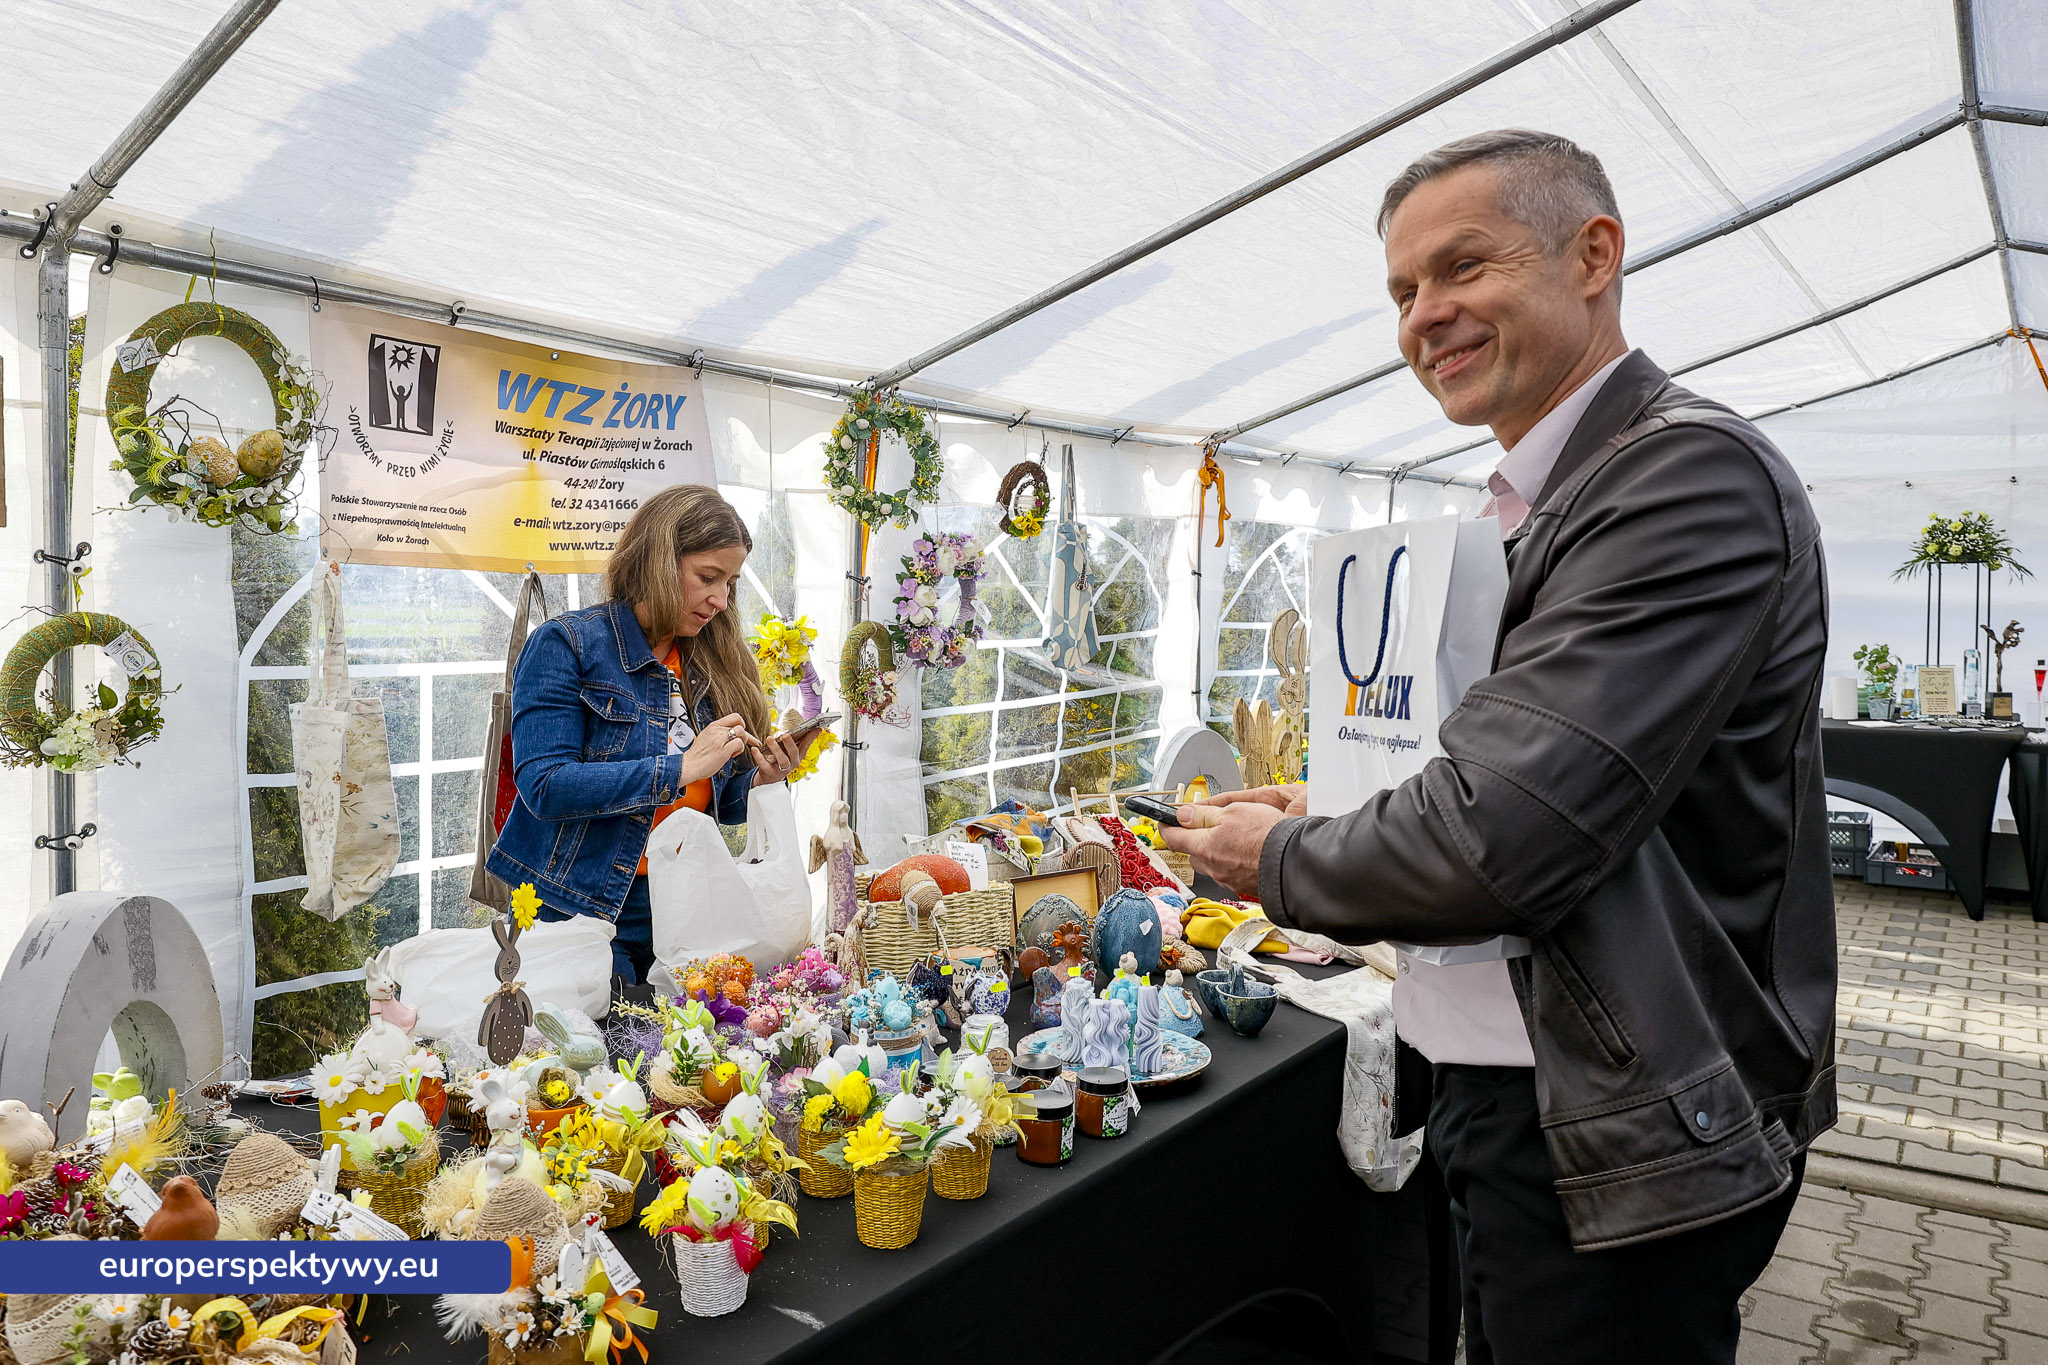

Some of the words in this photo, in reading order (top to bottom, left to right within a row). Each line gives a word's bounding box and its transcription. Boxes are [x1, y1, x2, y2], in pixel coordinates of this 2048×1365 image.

[497, 368, 606, 426] WTZ
[602, 382, 687, 430] ŻORY
[495, 420, 554, 443] Warsztaty
[557, 430, 600, 450] Terapii
[599, 437, 640, 451] Zajęciowej
[642, 440, 651, 450] w
[653, 437, 693, 451] Żorach
[386, 462, 416, 478] PRZED
[419, 453, 441, 475] NIMI
[522, 448, 537, 462] ul.
[539, 450, 590, 469] Piastów
[590, 457, 655, 472] Górnośląskich
[657, 459, 666, 470] 6
[564, 477, 598, 490] 44-240
[598, 475, 625, 492] Żory
[331, 494, 360, 505] Polskie
[361, 497, 418, 511] Stowarzyszenie
[419, 504, 428, 512] na
[429, 506, 447, 514] rzecz
[449, 507, 467, 516] Osób
[551, 497, 567, 510] tel.
[569, 498, 582, 510] 32
[585, 499, 639, 510] 4341666
[332, 513, 337, 521] z
[337, 512, 420, 530] Niepełnosprawnością
[420, 520, 466, 534] Intelektualną
[513, 515, 550, 530] e-mail:
[552, 519, 628, 533] wtz.zory@ps
[376, 533, 394, 543] Koło
[405, 534, 430, 545] Żorach
[1386, 733, 1421, 753] najlepsze!
